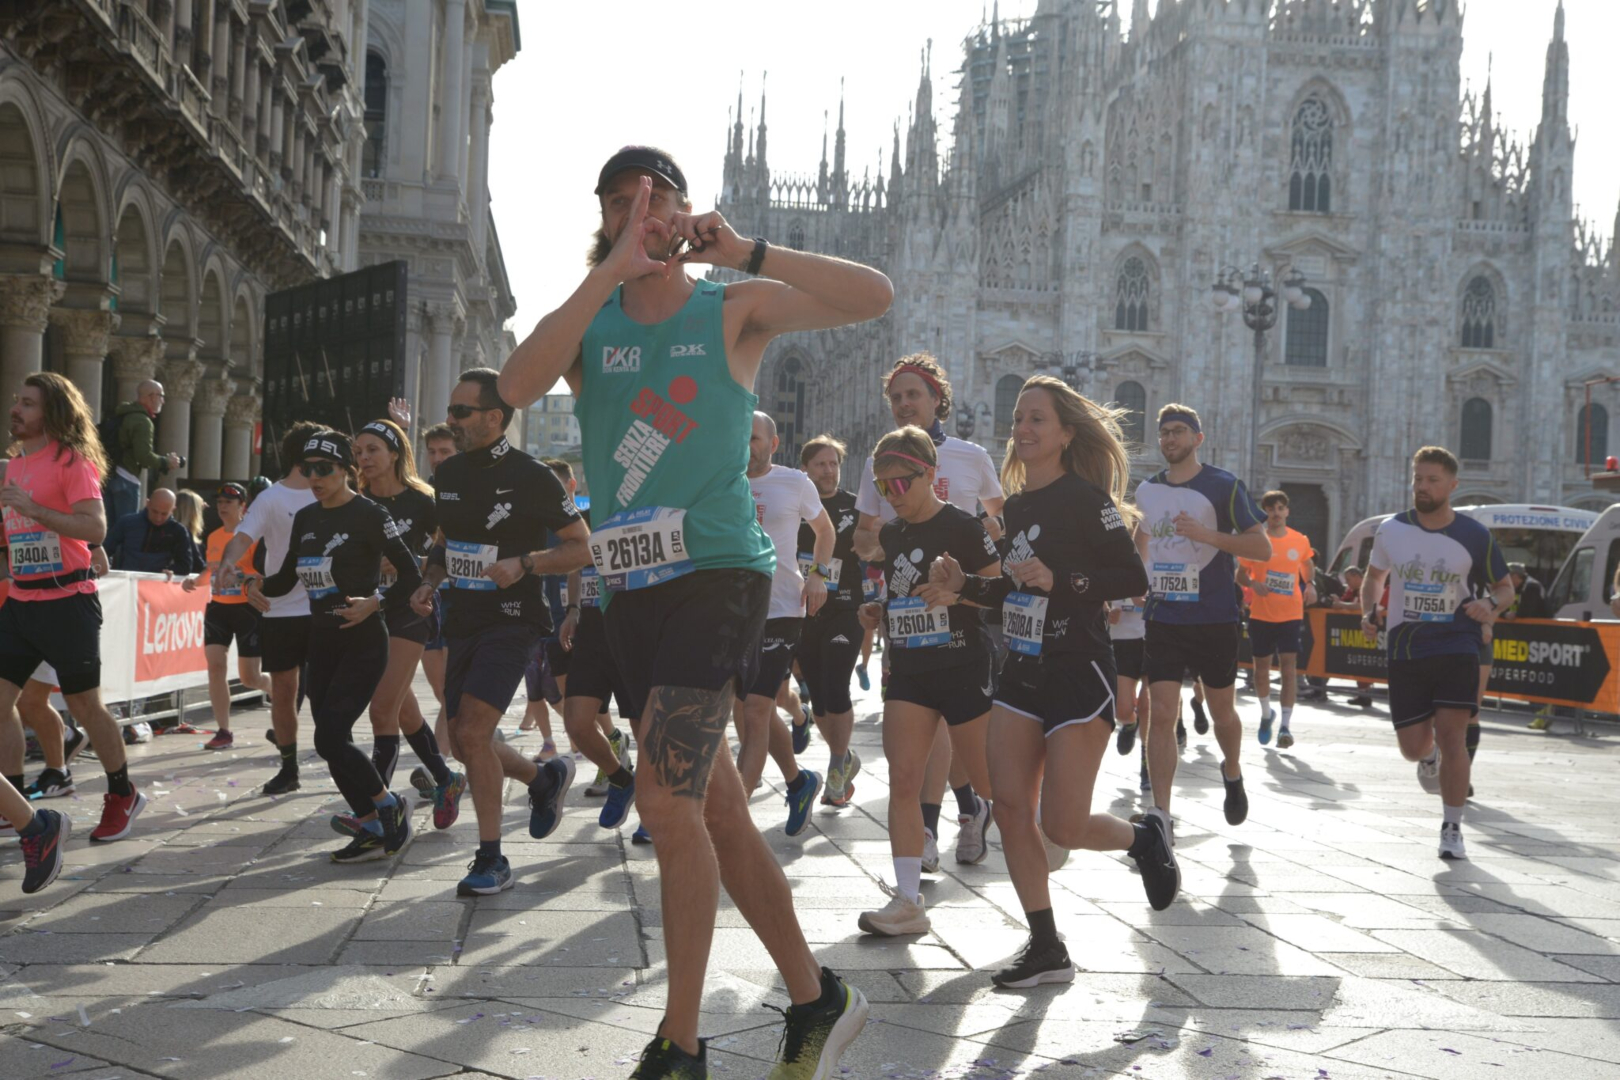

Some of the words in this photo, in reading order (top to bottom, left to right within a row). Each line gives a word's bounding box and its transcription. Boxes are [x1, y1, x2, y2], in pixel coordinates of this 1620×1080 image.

[602, 346, 641, 368] DKR
[630, 386, 699, 444] SPORT
[614, 419, 653, 469] SENZA
[616, 429, 671, 508] FRONTIERE
[1152, 522, 1175, 538] We
[1493, 514, 1560, 527] PROTEZIONE
[14, 546, 49, 564] 1340A
[607, 531, 667, 571] 2613A
[451, 557, 483, 580] 3281A
[893, 553, 922, 584] SPORT
[1393, 563, 1424, 583] We
[1430, 569, 1461, 583] run
[1160, 576, 1188, 592] 1752A
[501, 601, 521, 609] WHY
[504, 608, 521, 617] RUN
[1413, 596, 1446, 612] 1755A
[143, 602, 205, 655] Lenovo
[897, 613, 936, 635] 2610A
[951, 629, 965, 638] HY
[1006, 611, 1033, 639] 2608A
[948, 640, 966, 649] RUN
[1493, 639, 1584, 667] MEDSPORT
[1491, 667, 1554, 684] UPERFOOD
